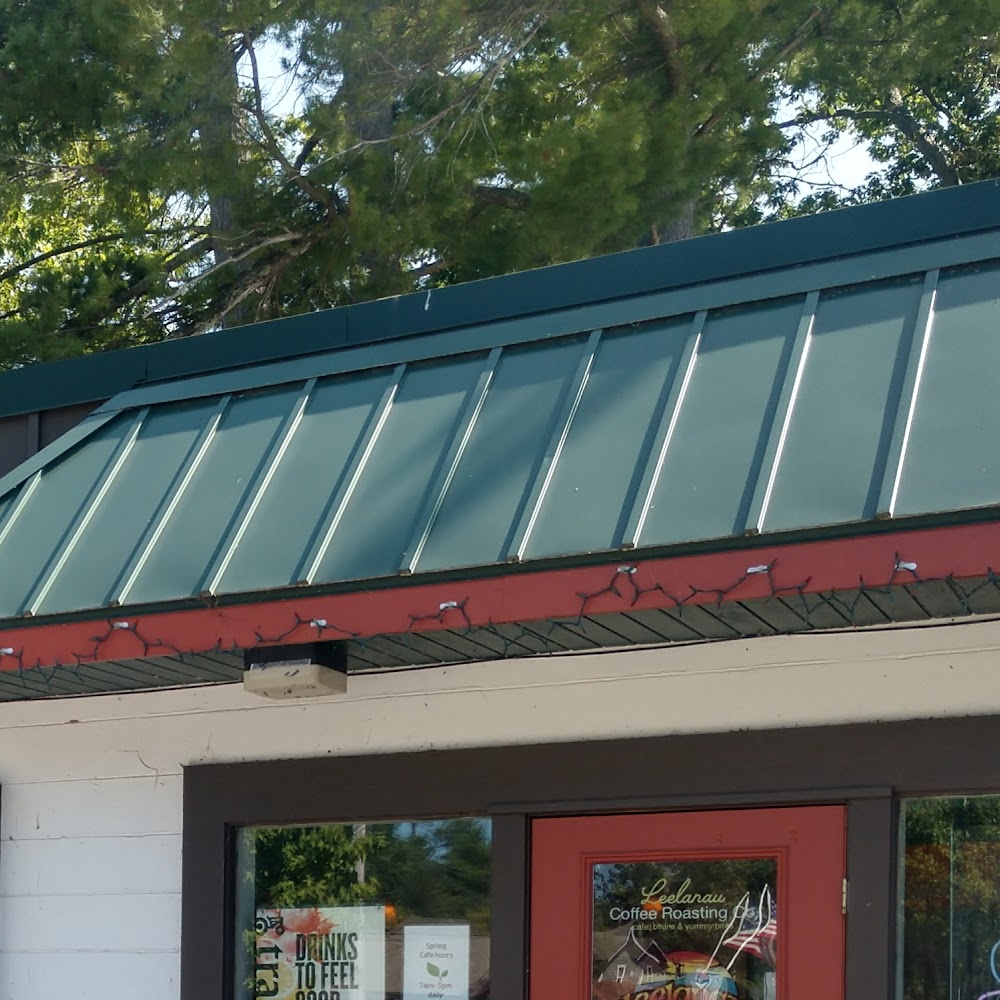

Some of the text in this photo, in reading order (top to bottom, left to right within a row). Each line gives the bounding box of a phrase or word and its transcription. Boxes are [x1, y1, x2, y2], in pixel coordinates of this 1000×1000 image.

[641, 878, 725, 904] Leelanau
[609, 906, 658, 920] Coffee
[661, 905, 728, 921] Roasting
[685, 923, 713, 931] yummy
[295, 932, 358, 961] DRINKS
[425, 942, 447, 950] Spring
[419, 951, 453, 959] Cafe hours
[295, 962, 358, 990] TO FEEL
[427, 991, 444, 1000] daily
